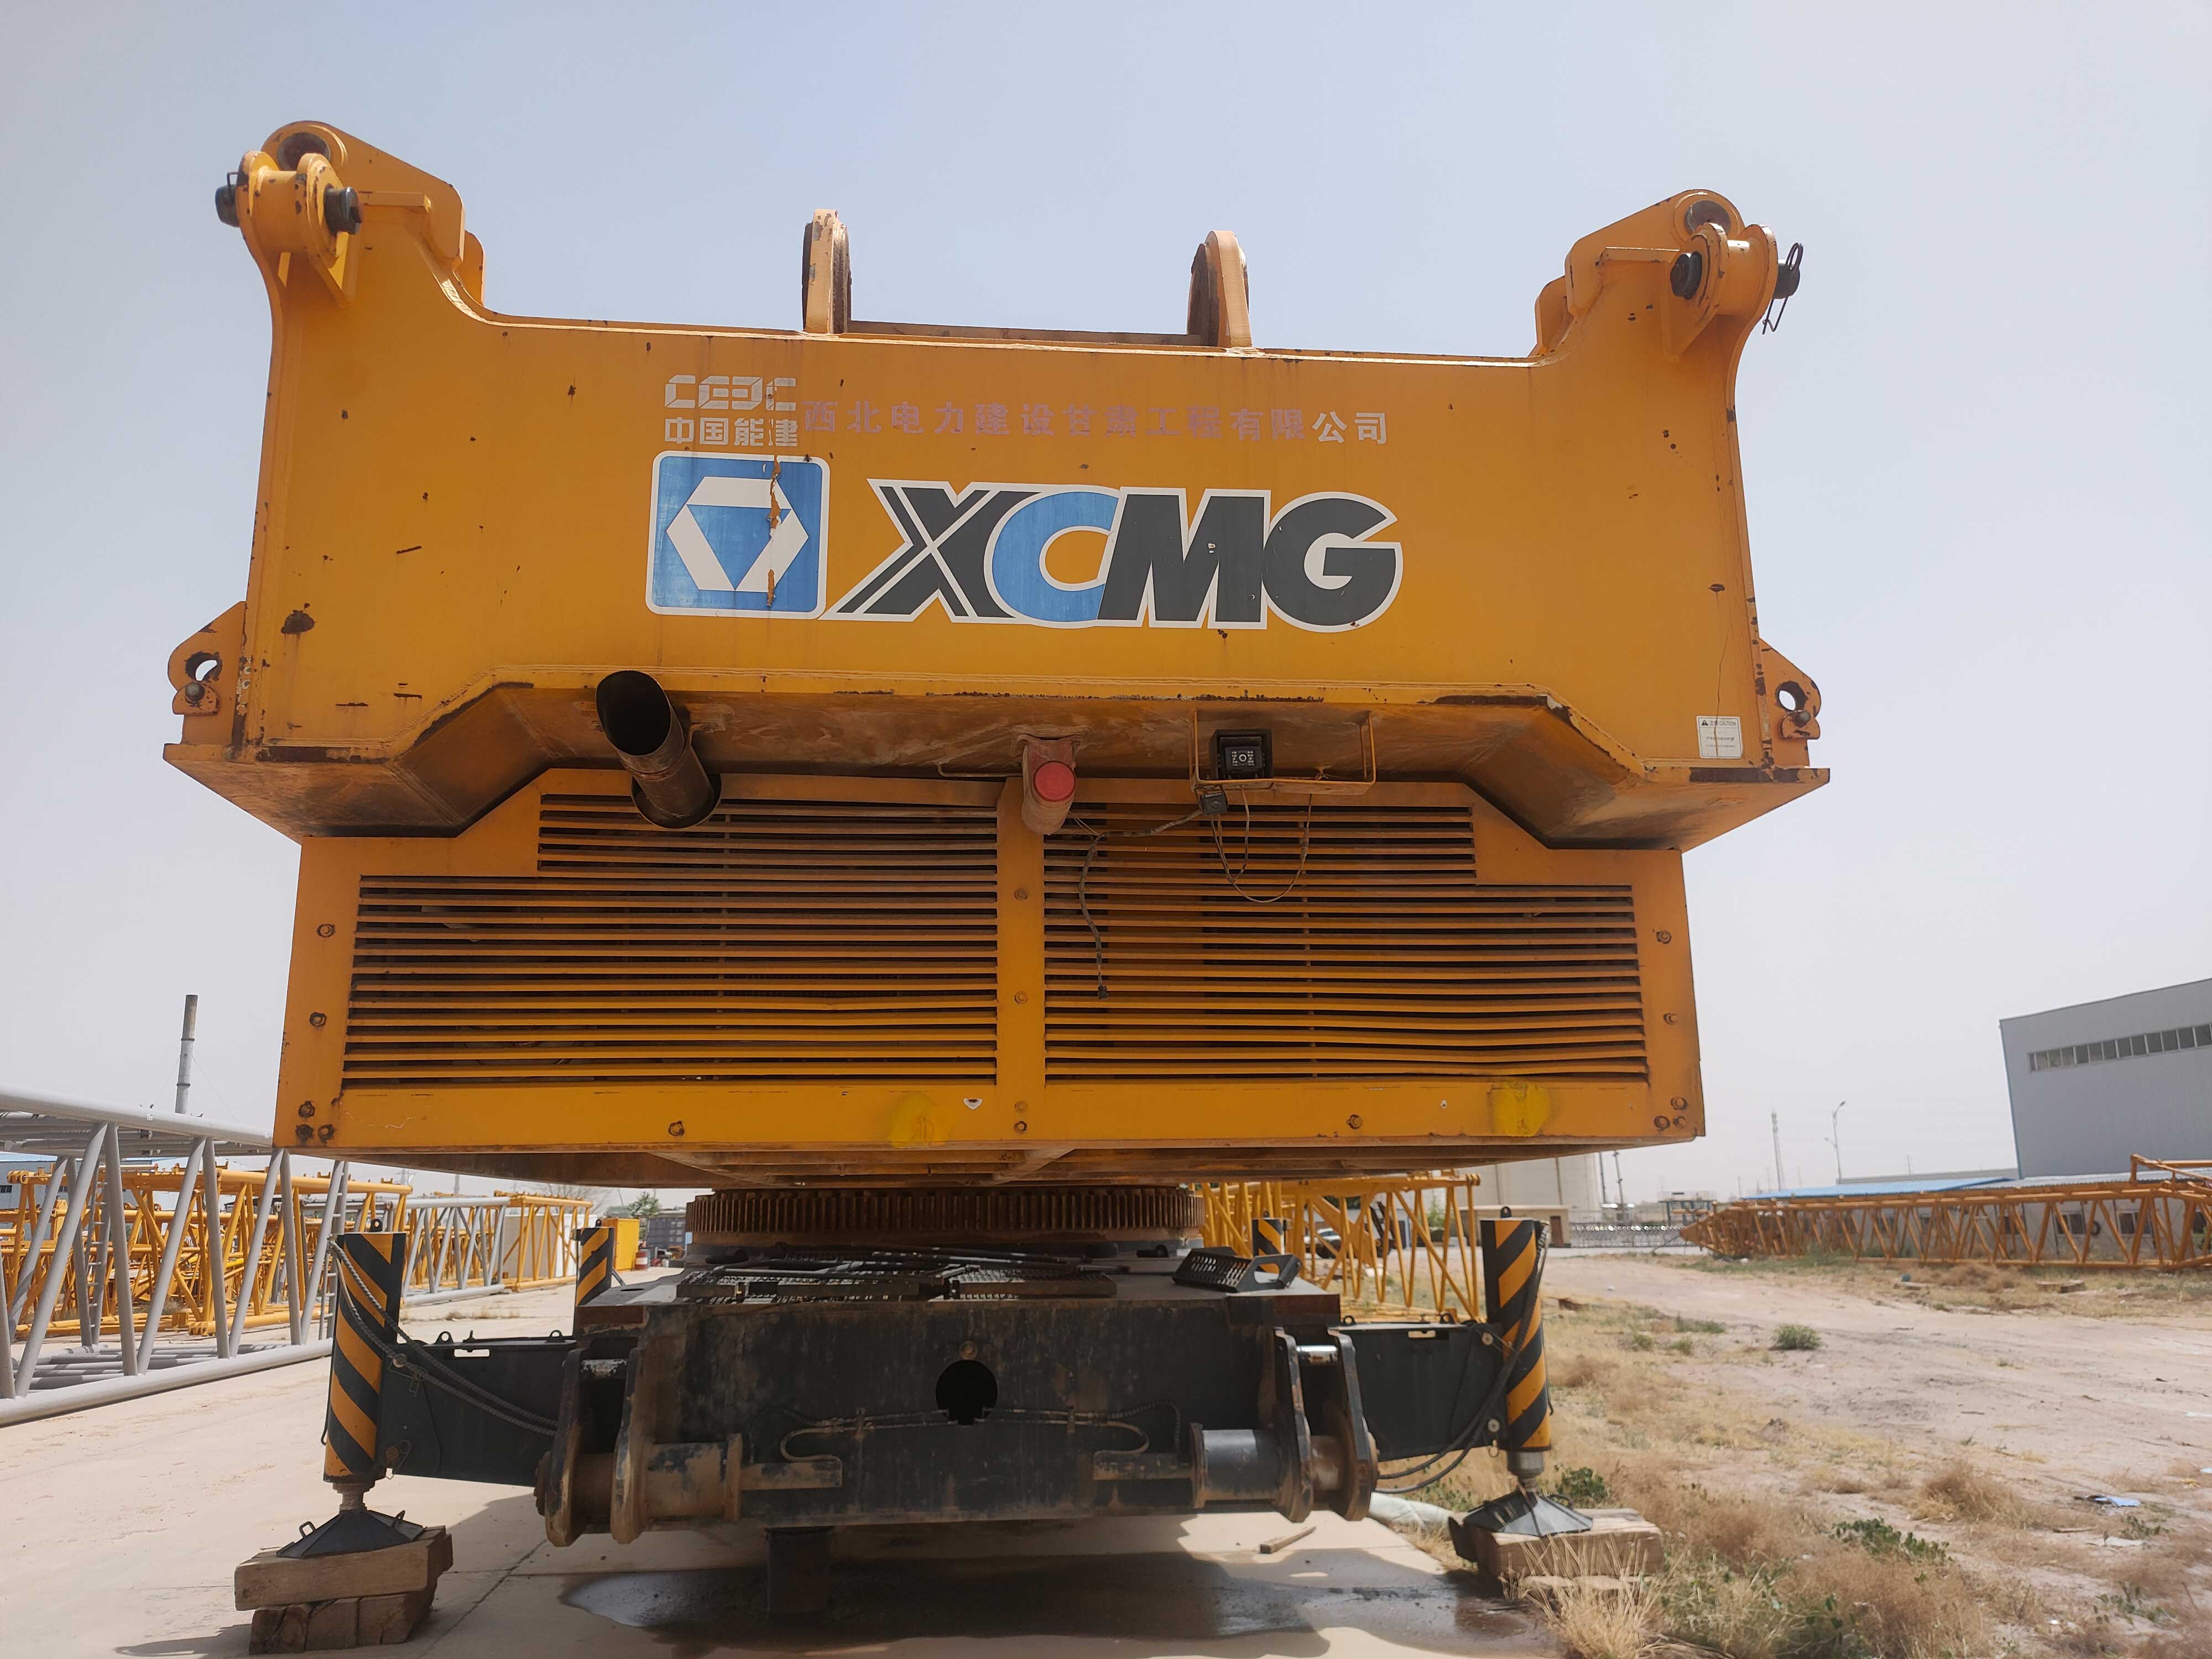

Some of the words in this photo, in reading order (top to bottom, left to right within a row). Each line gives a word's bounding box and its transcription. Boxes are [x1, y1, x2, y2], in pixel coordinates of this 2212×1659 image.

[665, 417, 798, 446] 中国能建
[802, 400, 1387, 444] 西北电力建设甘肃工程有限公司
[818, 479, 1403, 632] XCMG
